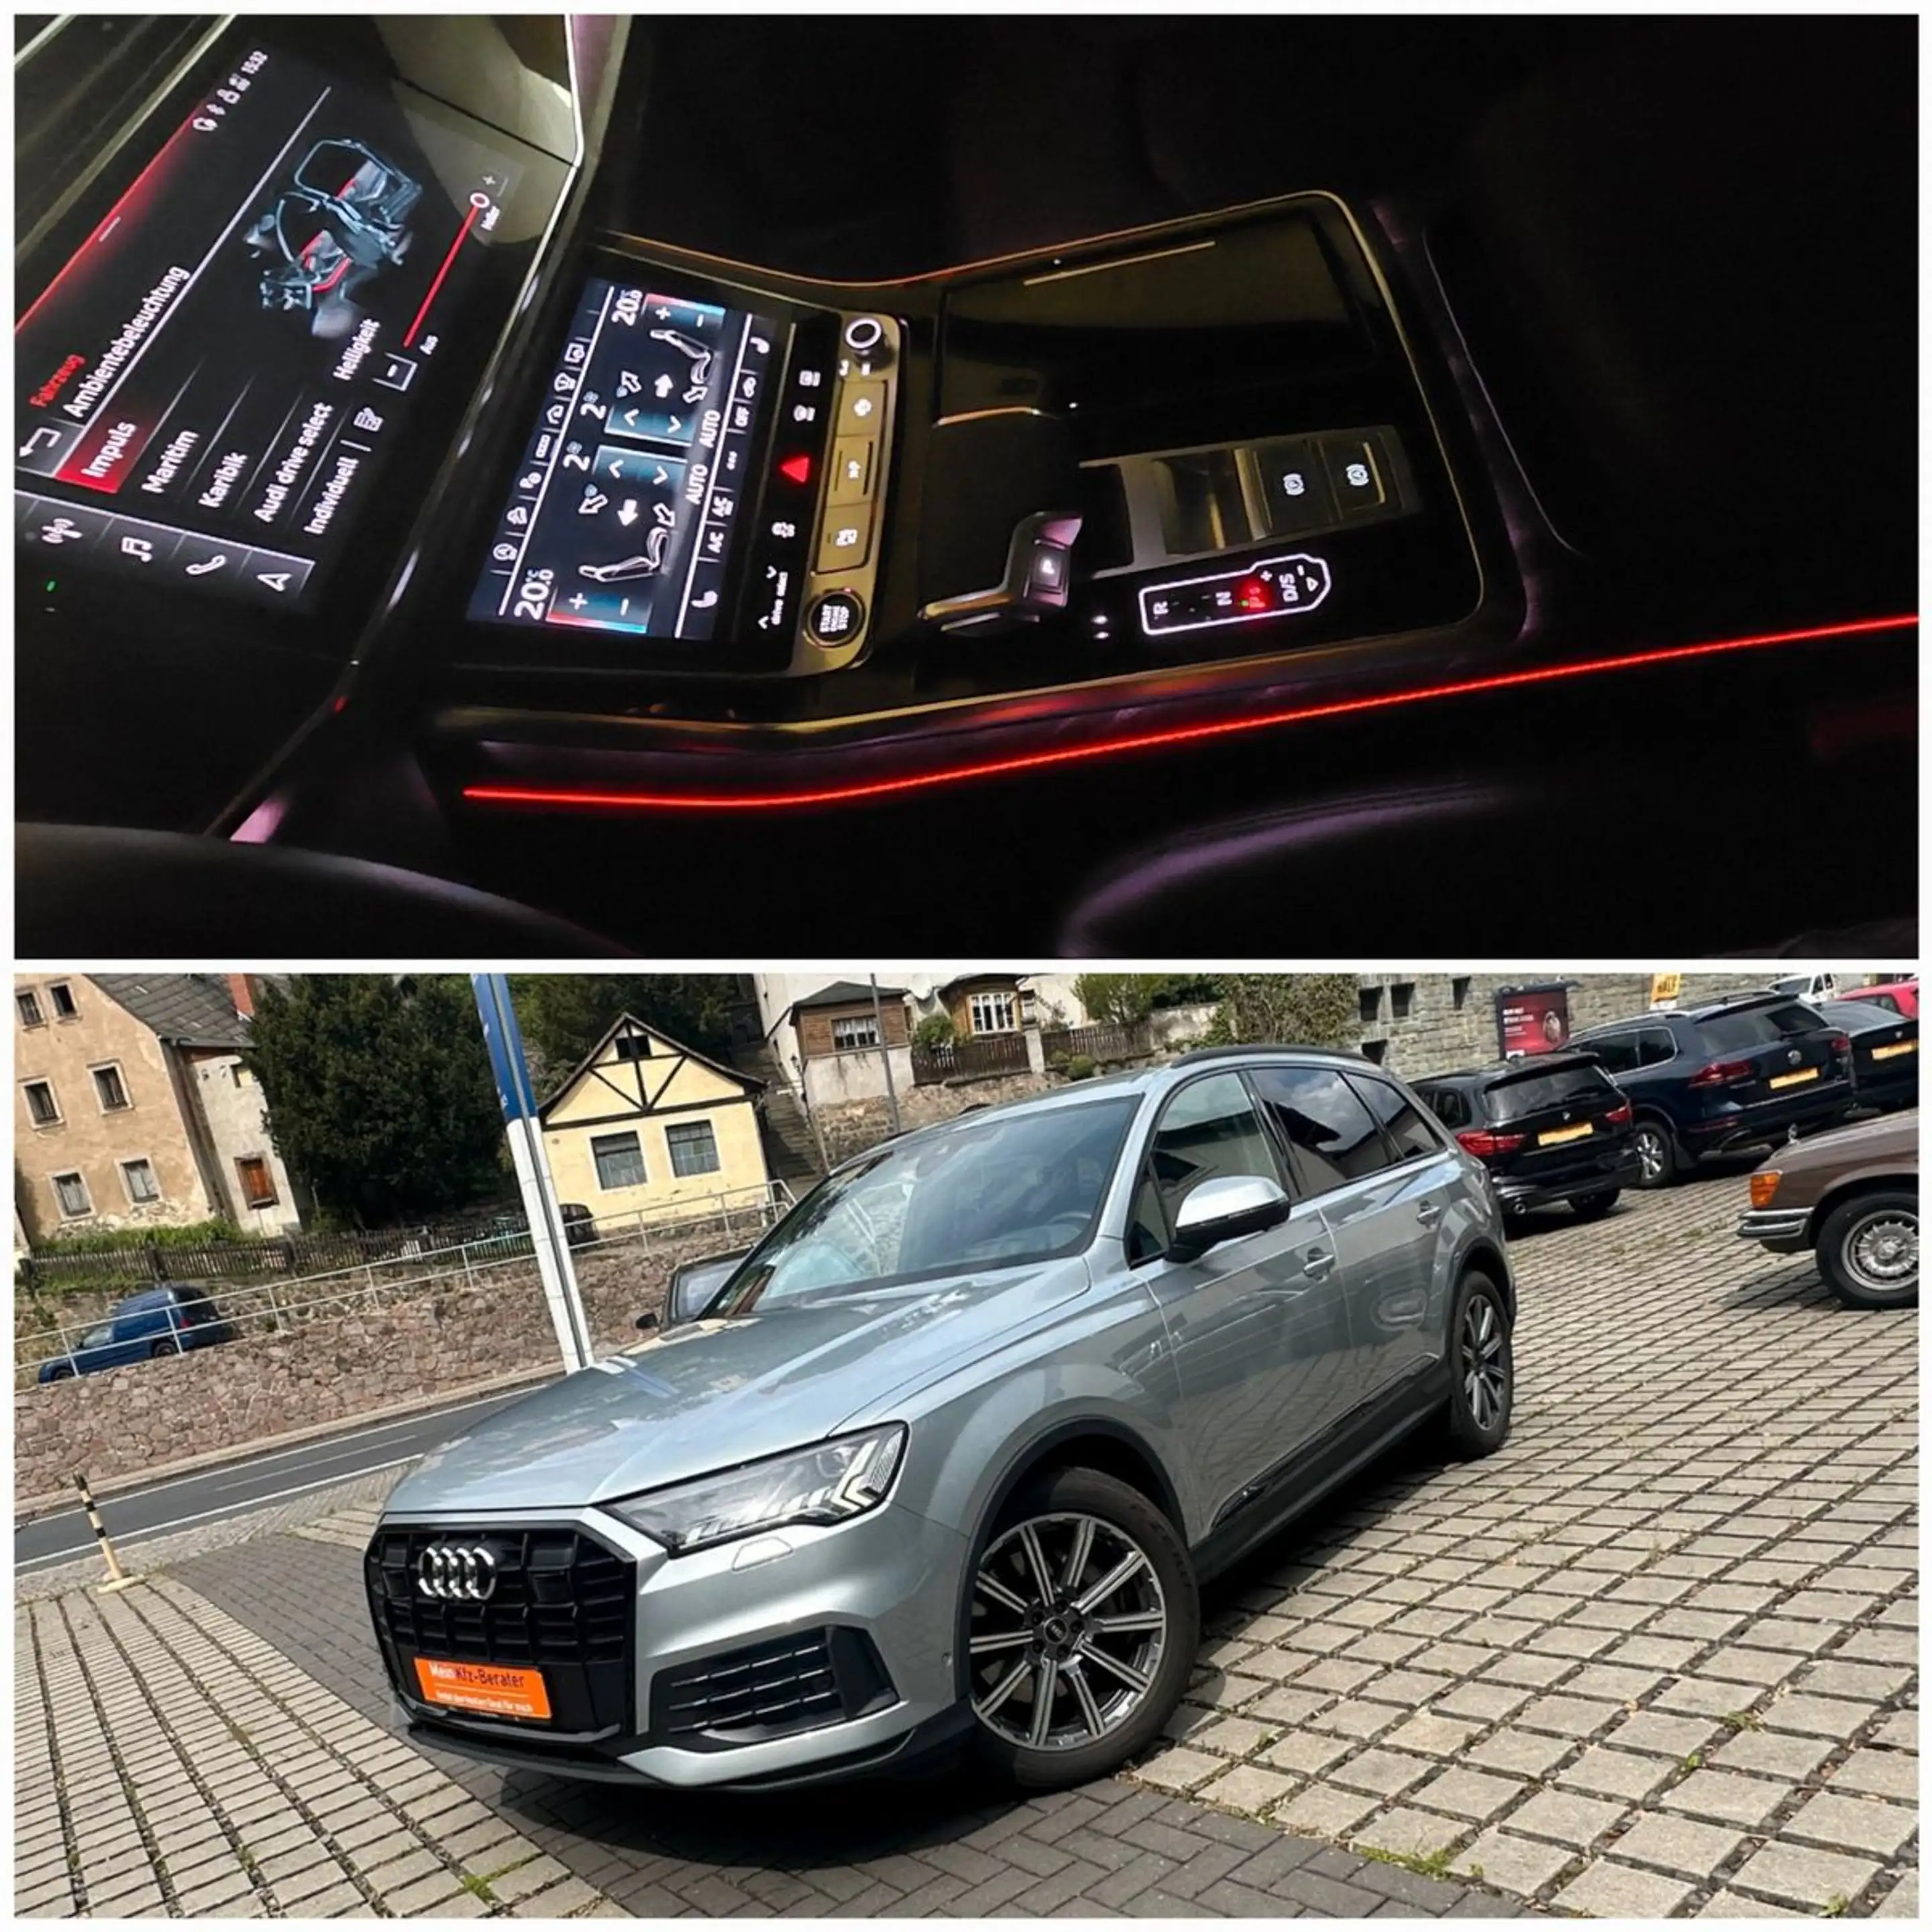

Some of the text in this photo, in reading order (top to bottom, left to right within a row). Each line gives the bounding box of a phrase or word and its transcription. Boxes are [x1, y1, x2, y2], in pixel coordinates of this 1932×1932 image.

[63, 265, 191, 419] Ambientebeleuchtung
[333, 318, 381, 380] Helligkeit
[29, 354, 86, 408] Fahrzeug
[698, 409, 721, 448] AUTO
[735, 406, 751, 428] OFF
[82, 421, 136, 479] Impuls
[142, 430, 200, 494] Maritim
[254, 401, 333, 523] Audi drive select
[199, 452, 249, 508] Karibik
[303, 458, 359, 535] Individuell
[684, 464, 708, 505] AUTO
[1152, 602, 1169, 615] R
[1216, 592, 1232, 606] N
[1279, 573, 1299, 603] D/S
[455, 1667, 525, 1688] Kfz-Berater
